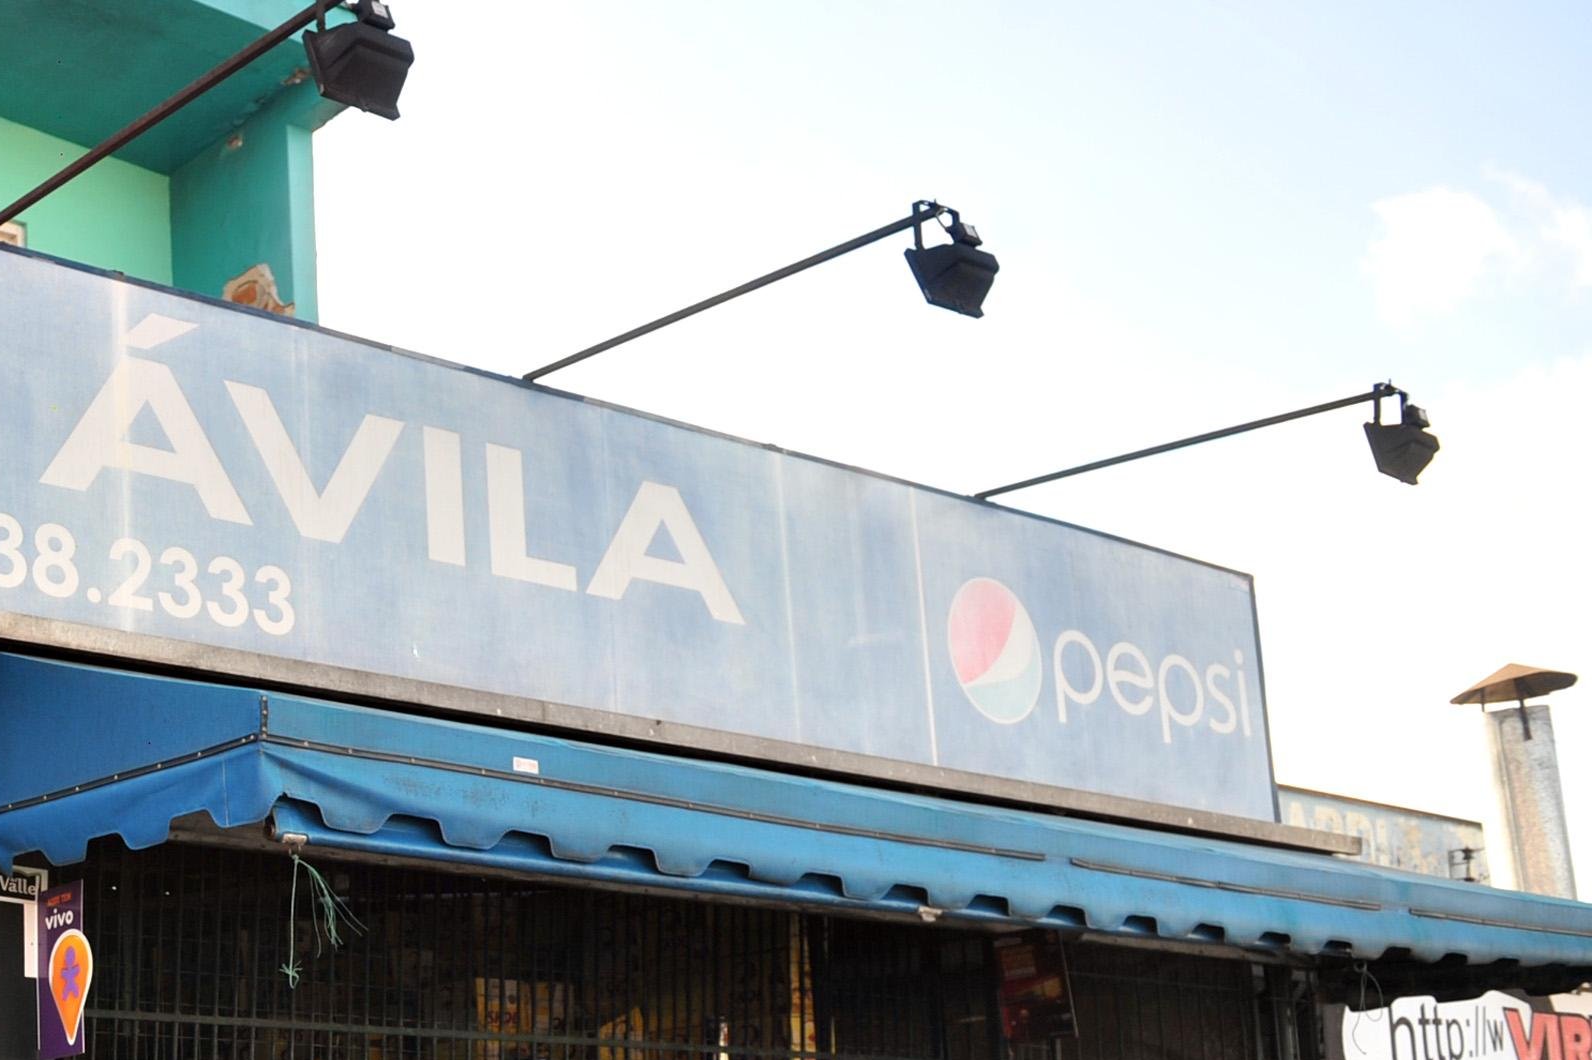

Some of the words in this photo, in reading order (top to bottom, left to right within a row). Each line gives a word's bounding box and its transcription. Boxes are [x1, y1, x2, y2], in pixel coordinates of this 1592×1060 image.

[39, 312, 748, 627] ÁVILA
[1053, 629, 1252, 744] pepsi
[45, 907, 74, 930] vivo
